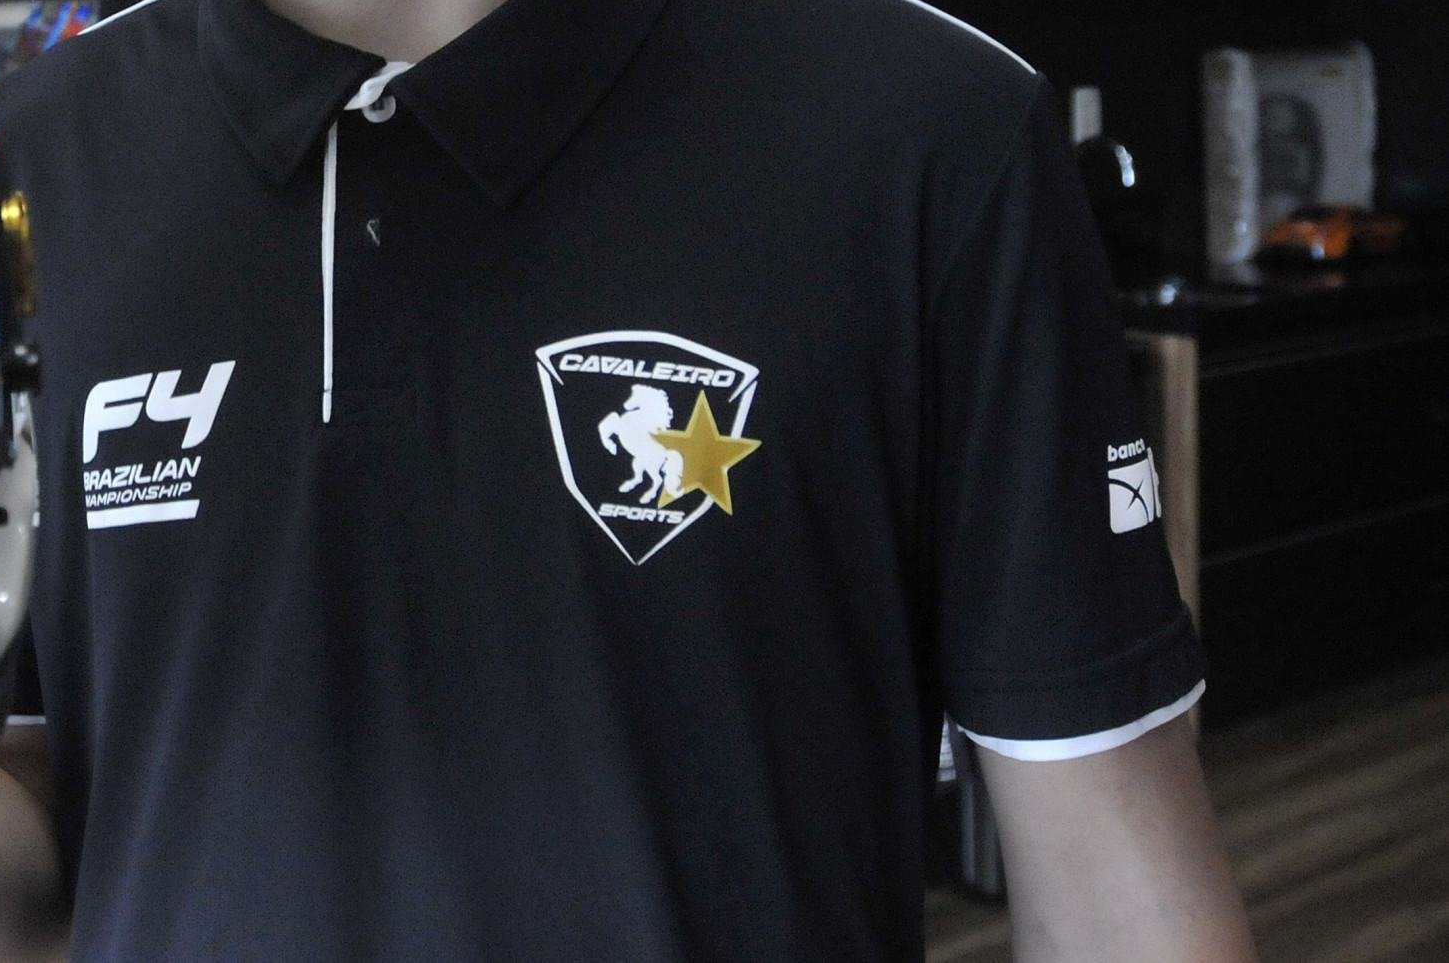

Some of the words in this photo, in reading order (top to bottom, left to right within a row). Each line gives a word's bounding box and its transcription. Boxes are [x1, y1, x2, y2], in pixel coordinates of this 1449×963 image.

[558, 354, 736, 388] CAVALEIRO
[82, 360, 236, 464] F4
[83, 456, 202, 491] BRAZILIAN
[597, 502, 686, 524] SPORTS
